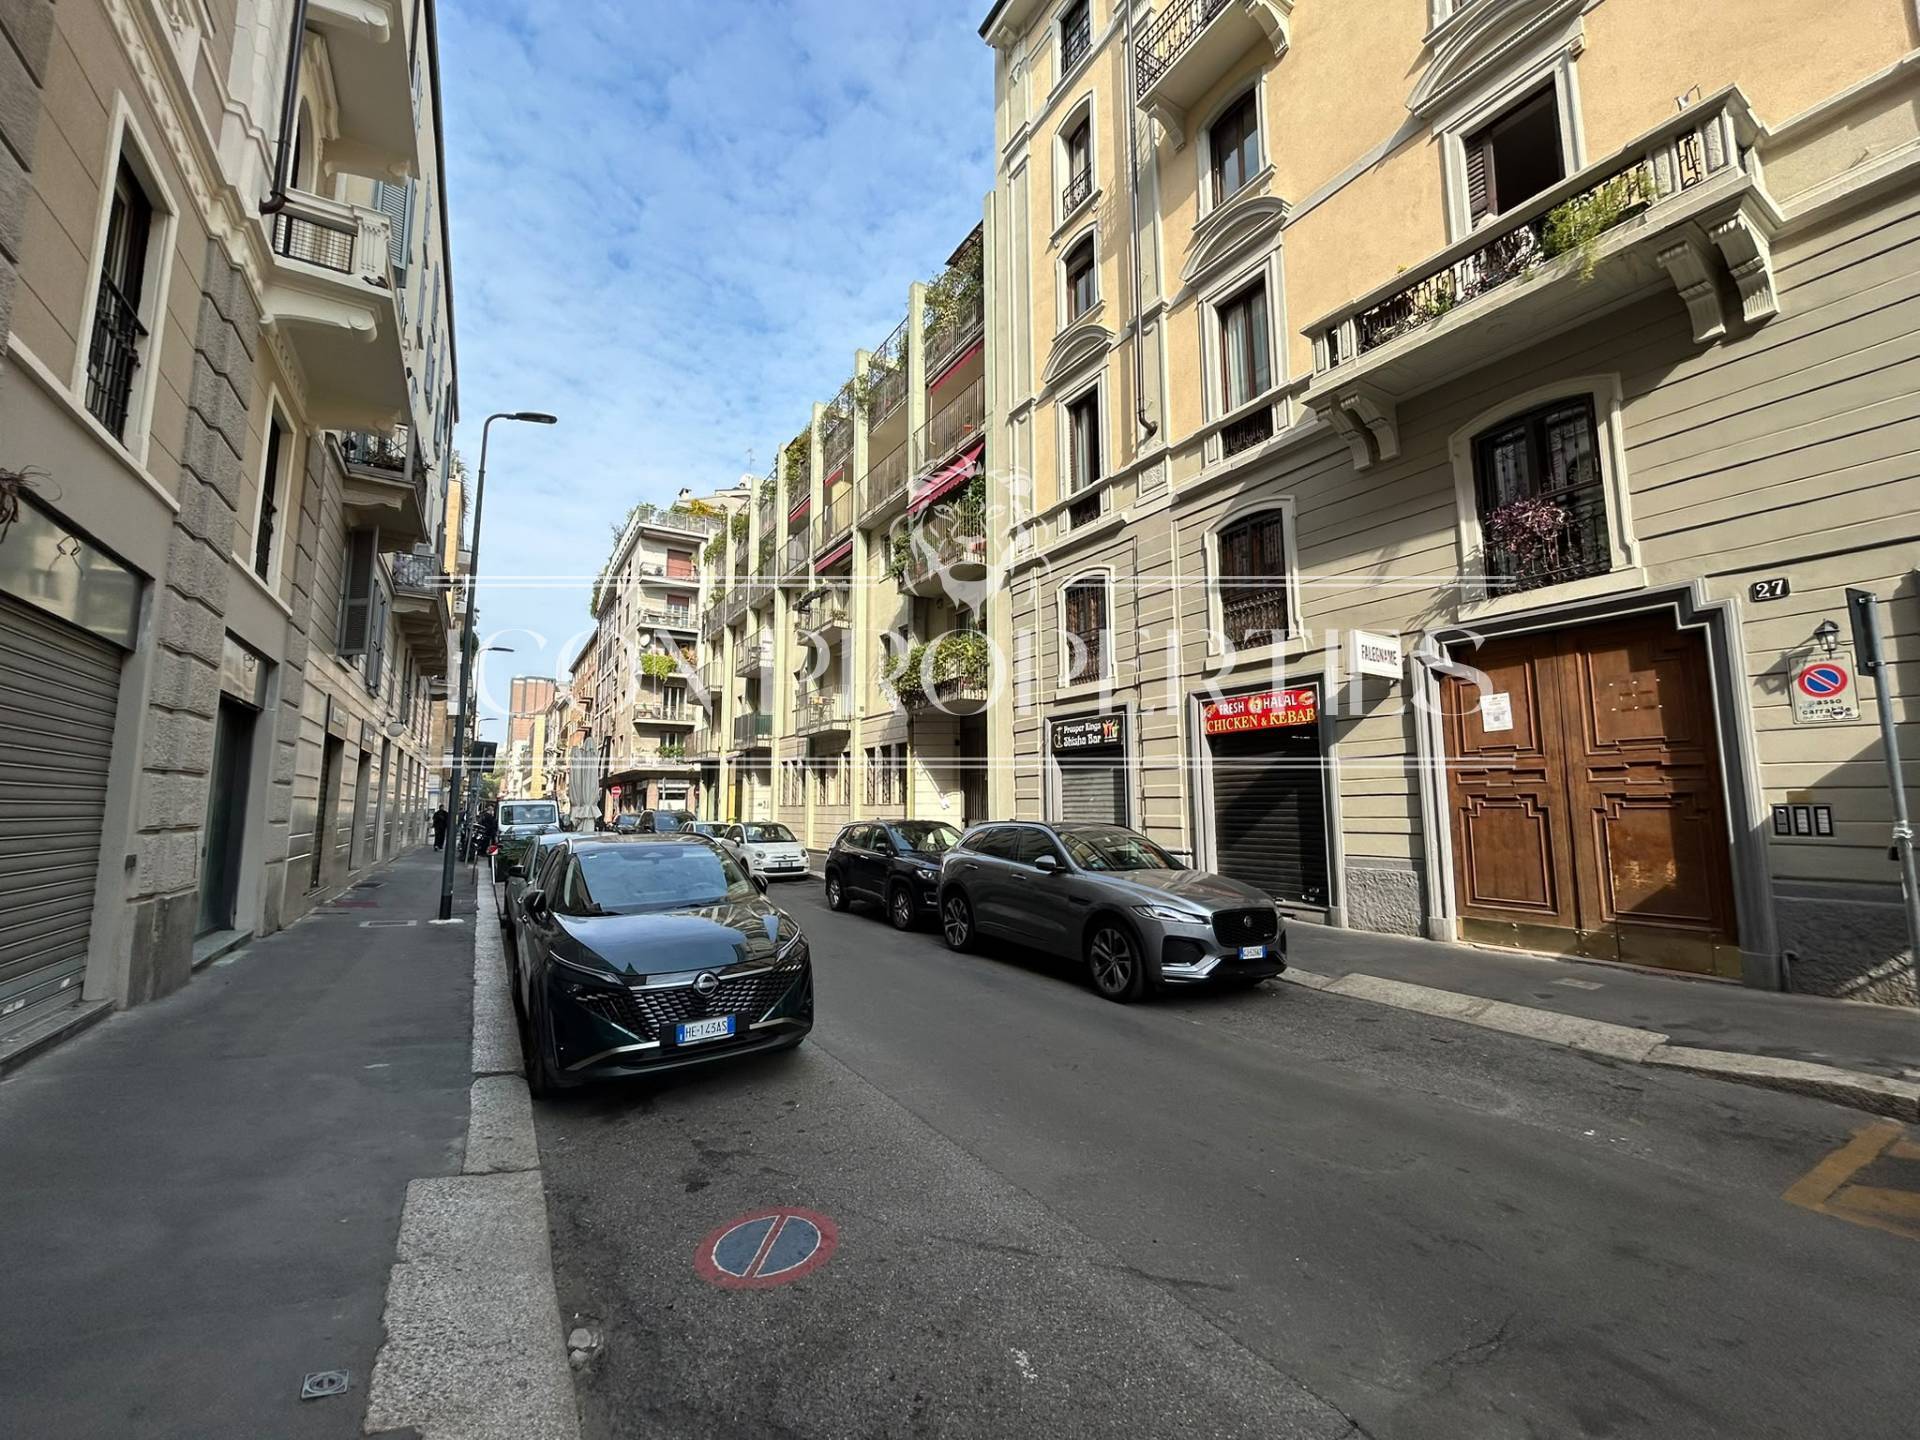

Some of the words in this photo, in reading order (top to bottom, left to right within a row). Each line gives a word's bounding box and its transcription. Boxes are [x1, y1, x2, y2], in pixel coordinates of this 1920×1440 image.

[1755, 579, 1783, 597] 27
[1361, 644, 1397, 666] FALEGNAME
[1219, 701, 1245, 715] FRESH
[1263, 694, 1297, 710] HALAL
[1206, 714, 1258, 733] CHICKEN
[1261, 719, 1267, 727] &
[1269, 708, 1316, 726] KEBAB
[1063, 736, 1087, 747] Shisha
[1087, 734, 1102, 745] Bar
